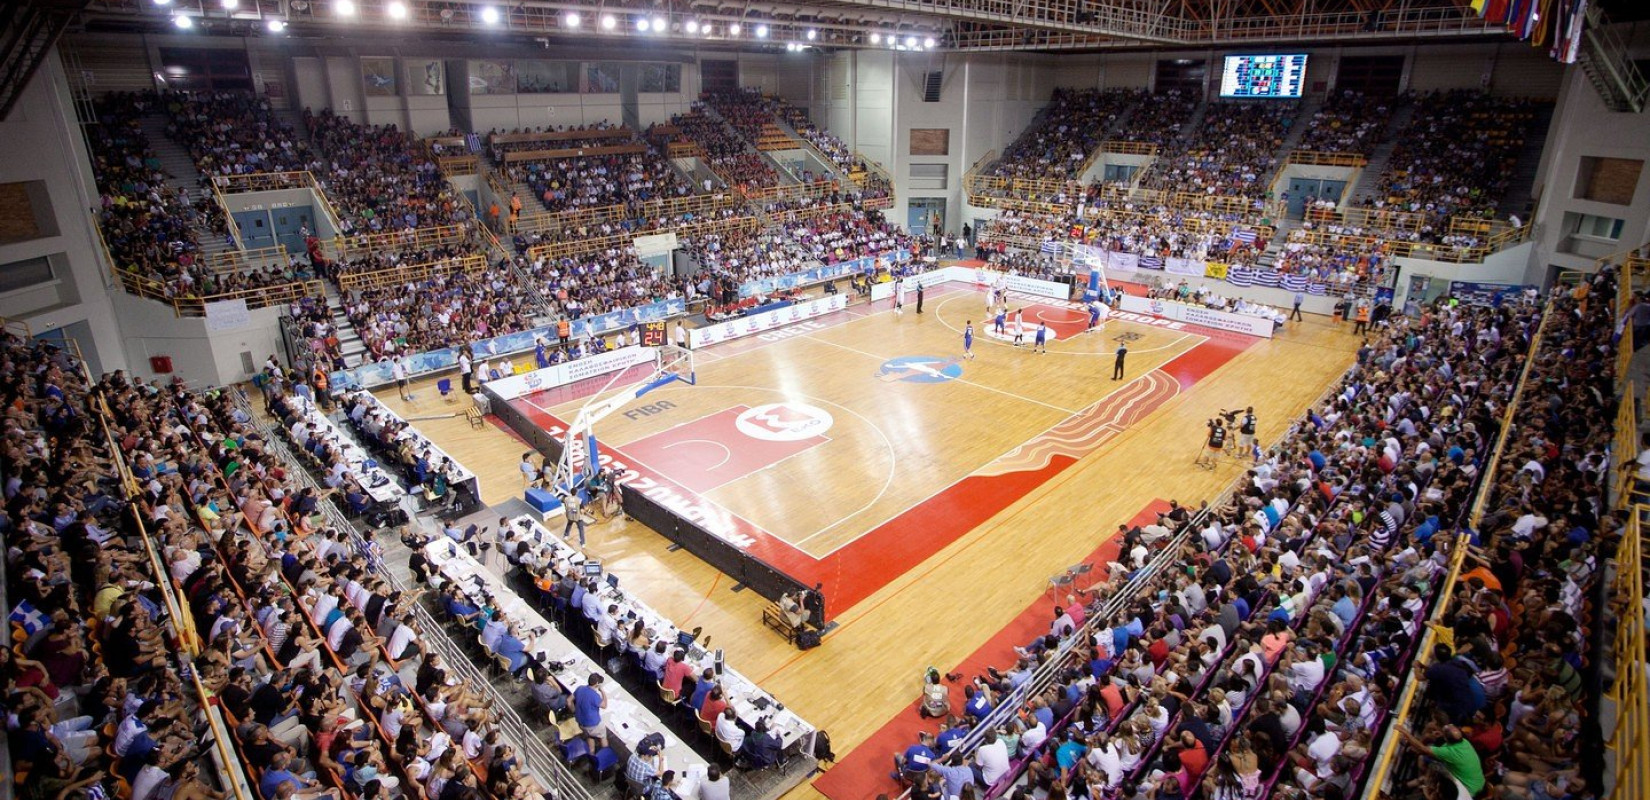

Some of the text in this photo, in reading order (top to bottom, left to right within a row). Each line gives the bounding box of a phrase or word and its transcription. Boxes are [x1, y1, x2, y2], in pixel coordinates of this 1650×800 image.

[644, 331, 663, 345] 24
[757, 320, 827, 342] CRETE
[621, 400, 678, 420] FIBA
